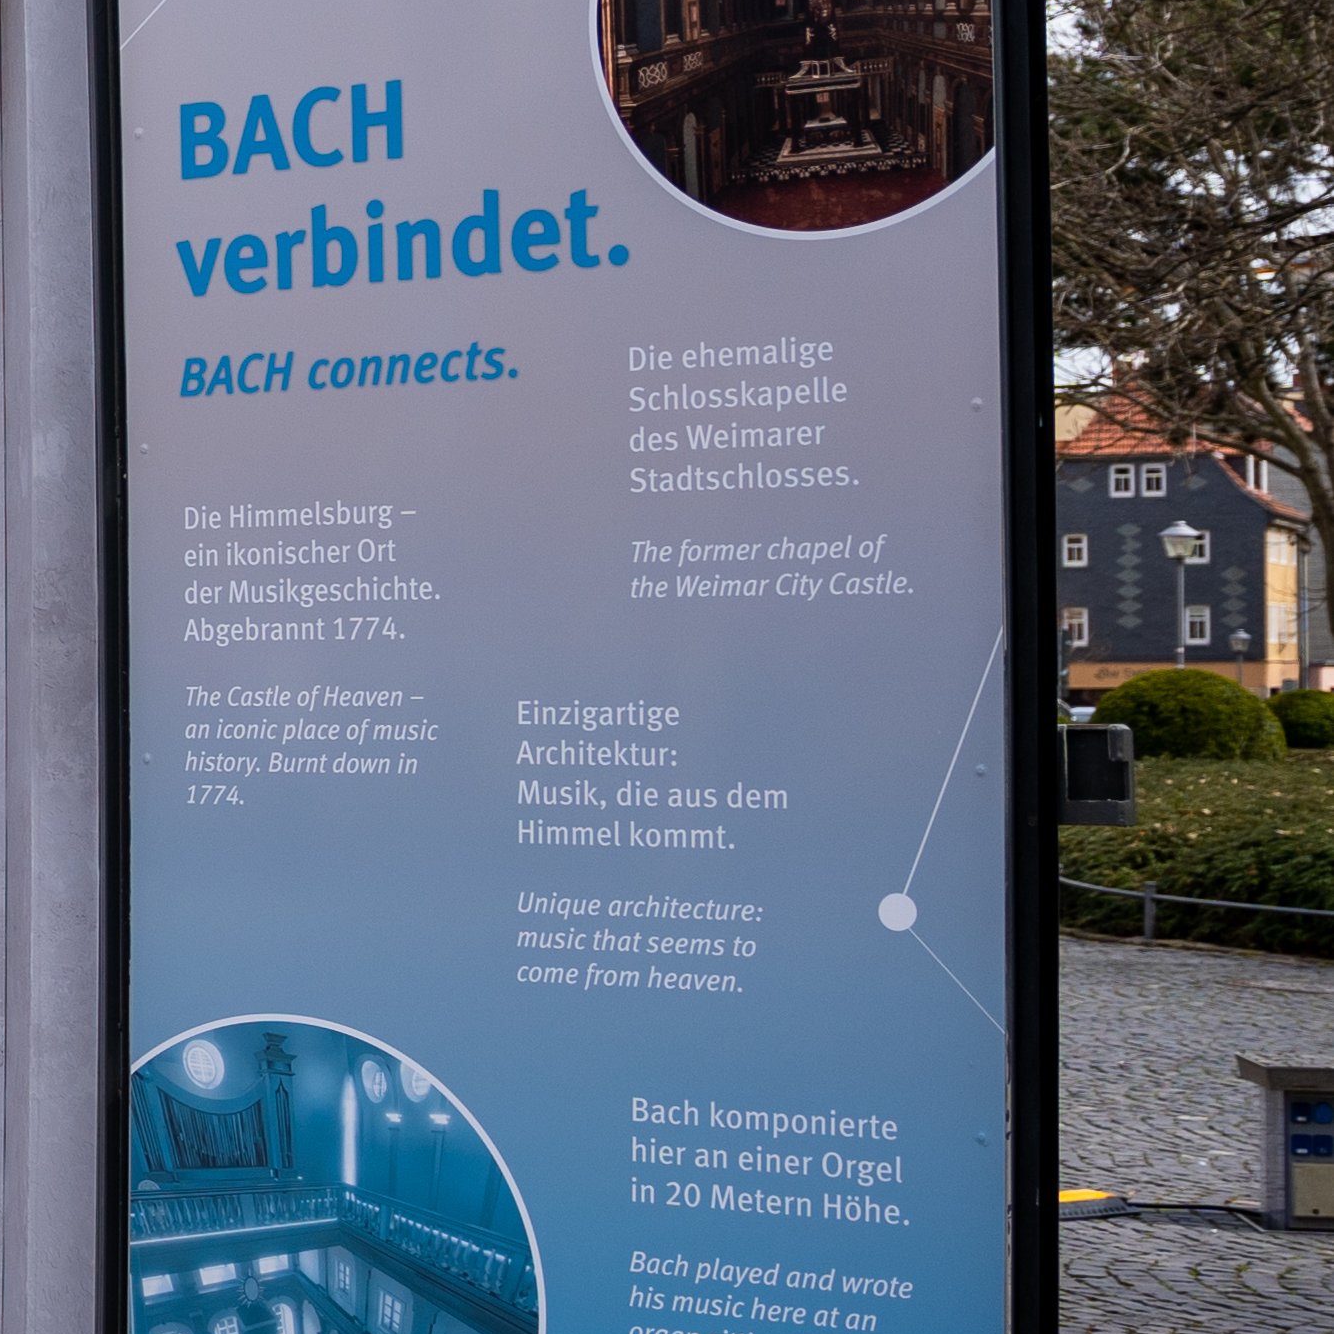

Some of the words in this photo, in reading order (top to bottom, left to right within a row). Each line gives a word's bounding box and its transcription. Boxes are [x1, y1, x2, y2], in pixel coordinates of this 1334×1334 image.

[180, 80, 403, 180] BACH
[176, 189, 629, 297] verbindet.
[630, 345, 672, 371] Die
[683, 337, 833, 368] ehemalige
[180, 351, 293, 397] BACH
[308, 342, 517, 390] connects.
[629, 376, 847, 411] Schlosskapelle
[630, 426, 678, 452] des
[686, 422, 825, 449] Weimarer
[630, 462, 859, 492] Stadtschlosses.
[185, 506, 221, 529] Die
[230, 500, 393, 529] Himmelsburg
[185, 543, 218, 567] ein
[227, 540, 350, 565] ikonischer
[358, 539, 396, 562] Ort
[632, 540, 672, 562] The
[678, 539, 761, 567] former
[767, 535, 852, 564] chapel
[859, 534, 887, 563] of
[185, 580, 222, 604] der
[229, 576, 440, 607] Musikgeschichte.
[631, 575, 668, 598] the
[677, 575, 769, 597] Weimar
[776, 573, 823, 601] City
[829, 571, 913, 595] Castle.
[184, 617, 324, 646] Abgebrannt
[334, 617, 404, 640] 1774.
[518, 700, 679, 731] Einzigartige
[516, 740, 676, 766] Architektur:
[518, 780, 606, 809] Musik,
[617, 780, 658, 806] die
[668, 789, 717, 807] aus
[727, 782, 787, 809] dem
[519, 819, 620, 846] Himmel
[630, 821, 734, 849] kommt.
[518, 892, 600, 919] Unique
[608, 895, 763, 922] architecture:
[517, 928, 586, 949] music
[593, 929, 642, 952] that
[646, 937, 725, 955] seems
[733, 937, 756, 957] to
[517, 966, 578, 984] come
[584, 963, 639, 990] from
[648, 966, 742, 992] heaven.
[632, 1097, 698, 1125] Bach
[711, 1102, 897, 1140] komponierte
[632, 1136, 686, 1165] hier
[695, 1149, 727, 1168] an
[739, 1146, 812, 1175] einer
[822, 1152, 902, 1186] Orgel
[632, 1177, 654, 1203] in
[666, 1182, 700, 1207] 20
[711, 1184, 811, 1217] Metern
[824, 1194, 909, 1226] Höhe.
